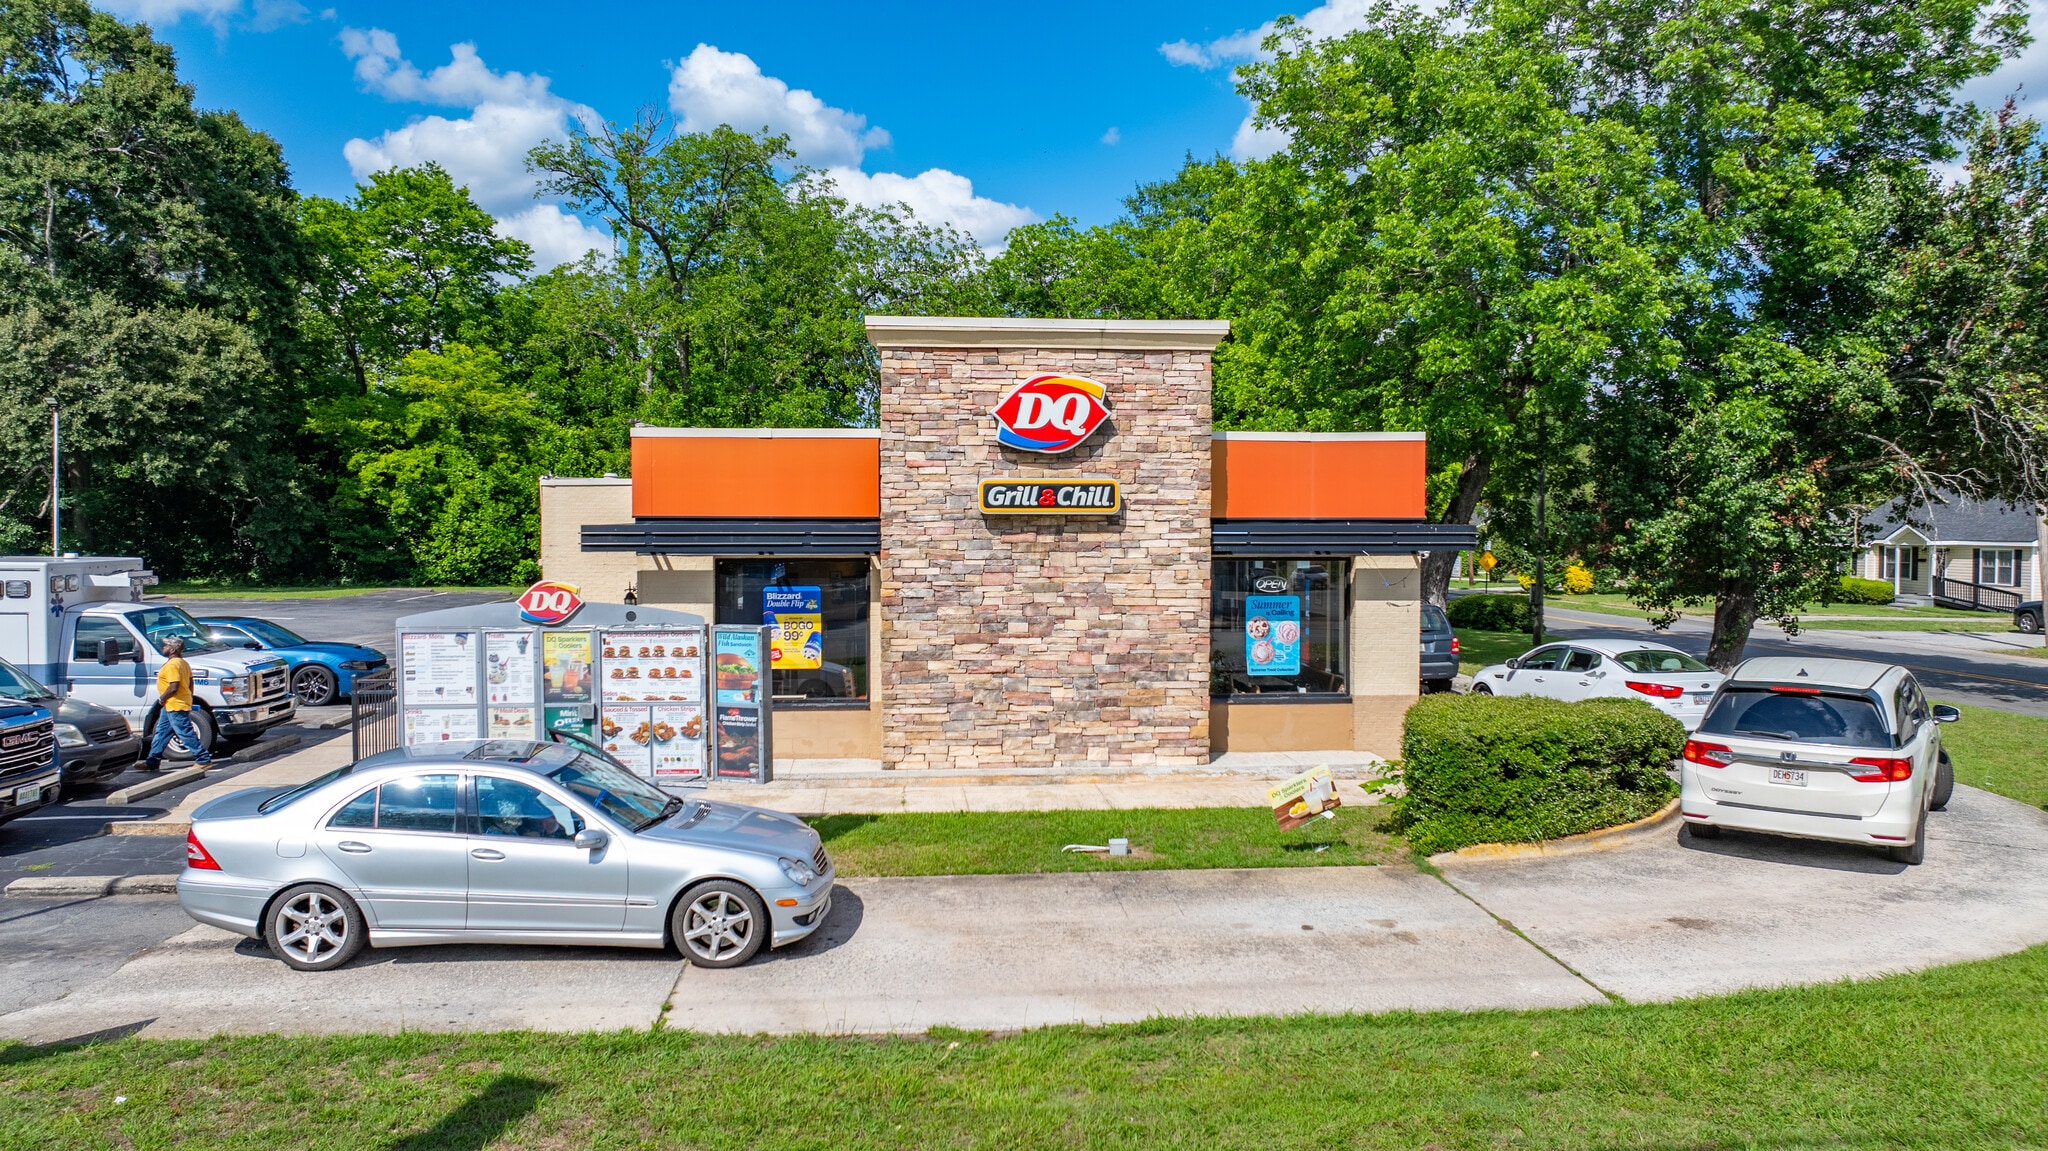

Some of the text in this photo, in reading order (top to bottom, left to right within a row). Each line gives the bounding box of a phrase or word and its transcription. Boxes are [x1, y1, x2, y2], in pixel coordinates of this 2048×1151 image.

[1012, 392, 1091, 436] DQ
[1255, 580, 1287, 590] OPEN
[766, 592, 801, 600] Blizzard
[528, 590, 572, 614] DQ
[766, 600, 790, 608] Double
[791, 600, 805, 609] Flip
[1251, 600, 1292, 610] Summer
[1271, 609, 1295, 617] Calling
[783, 621, 814, 630] BOGO
[731, 632, 755, 641] Alaskan
[783, 631, 804, 640] 99¢
[2, 731, 40, 748] GMC
[1271, 790, 1281, 798] DQ
